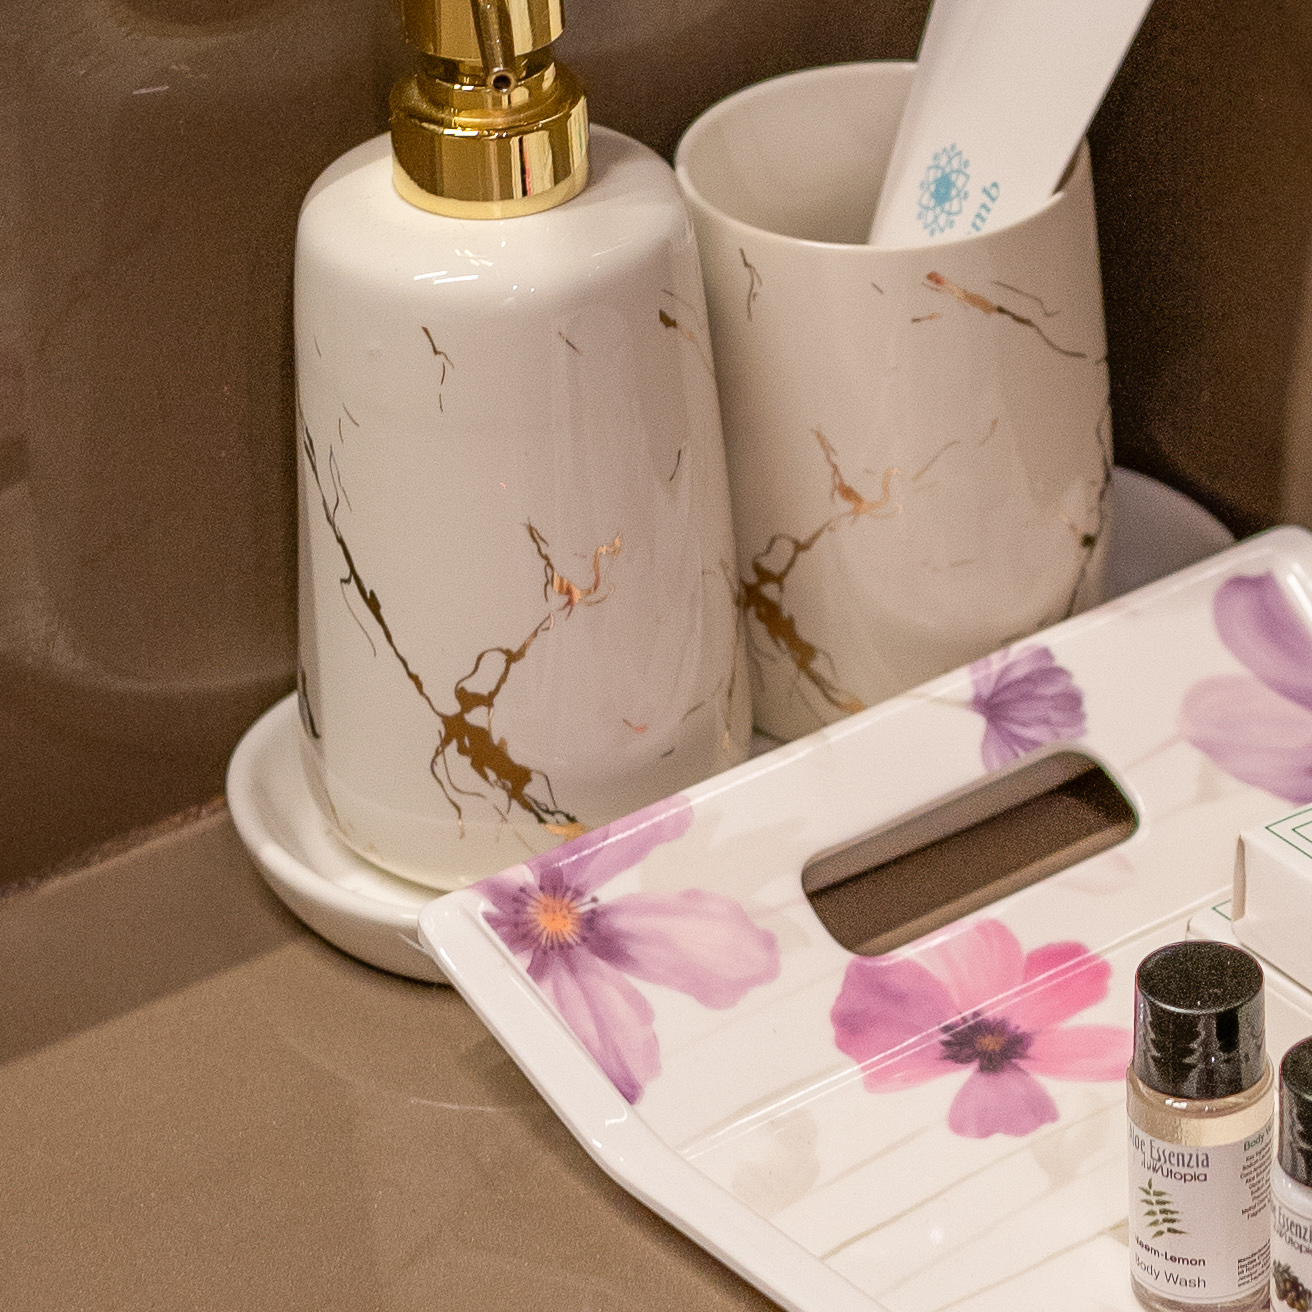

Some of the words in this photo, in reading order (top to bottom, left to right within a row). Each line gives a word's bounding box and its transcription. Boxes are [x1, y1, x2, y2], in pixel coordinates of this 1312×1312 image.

[1150, 1139, 1210, 1169] Essenzia
[1135, 1252, 1160, 1281] Body
[1164, 1270, 1207, 1289] Wash
